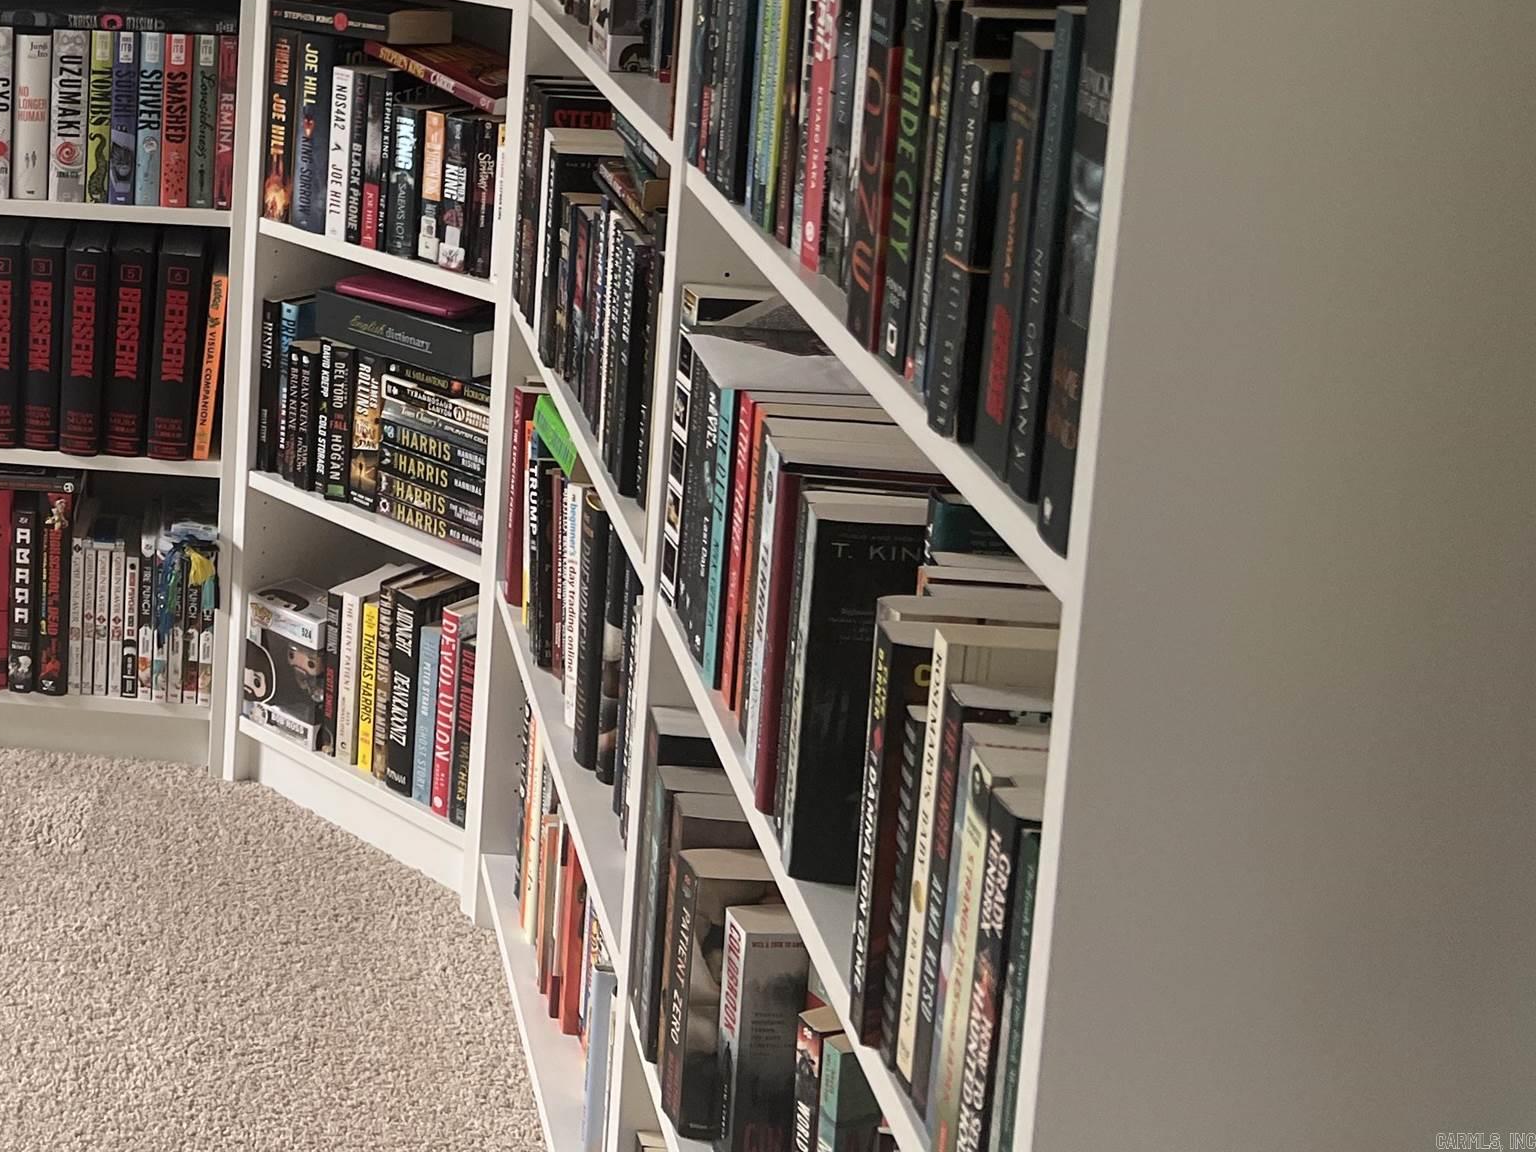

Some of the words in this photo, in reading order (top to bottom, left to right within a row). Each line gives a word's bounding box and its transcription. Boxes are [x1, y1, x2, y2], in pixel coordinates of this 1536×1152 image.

[283, 11, 315, 22] STEPHEN
[316, 15, 334, 25] KING
[304, 43, 319, 74] JOE
[378, 46, 410, 72] STEPHEN
[407, 62, 426, 79] KING
[18, 86, 30, 97] NO
[18, 98, 48, 109] LONGER
[57, 55, 83, 138] UZUMAKI
[90, 67, 113, 126] TOMBS
[138, 69, 163, 131] SHIVER
[165, 71, 188, 144] SMASHED
[272, 93, 287, 123] JOE
[303, 76, 318, 107] HILL
[333, 84, 348, 131] NOS4A2
[897, 48, 922, 162] JADE
[17, 110, 46, 122] HUMAN
[218, 93, 235, 153] REMINA
[383, 91, 393, 135] STEPHEN
[270, 124, 286, 156] HILL
[382, 136, 391, 160] KING
[331, 163, 344, 190] JOE
[351, 142, 363, 187] BLACK
[444, 163, 458, 201] KING
[298, 165, 313, 214] SORROW
[954, 118, 975, 251] NEVERWHERE
[328, 191, 342, 216] HILL
[347, 189, 362, 231] PHONE
[890, 170, 913, 264] CITY
[1031, 248, 1045, 303] NEIL
[28, 280, 53, 373] BERSERK
[70, 286, 96, 379] BERSERK
[115, 287, 141, 380] BERSERK
[161, 289, 189, 383] BERSERK
[386, 328, 432, 350] dictionary
[206, 331, 216, 365] VISUAL
[322, 344, 331, 369] DAVID
[290, 366, 299, 397] BRIAN
[301, 369, 311, 398] BRIAN
[320, 370, 330, 398] KOEPP
[334, 362, 345, 380] DEL
[200, 367, 213, 426] COMPANION
[332, 381, 344, 409] TORO
[357, 363, 372, 417] ROLLINS
[370, 377, 379, 409] JAMES
[406, 389, 453, 410] TYRANNOSAUR
[288, 398, 297, 432] KEENE
[298, 400, 309, 434] KEENE
[318, 415, 328, 435] COLD
[427, 402, 453, 418] CANYON
[316, 436, 326, 475] STORAGE
[330, 434, 342, 480] HOGAN
[401, 427, 451, 462] HARRIS
[457, 449, 485, 466] HANNIBAL
[399, 453, 449, 489] HARRIS
[461, 457, 481, 472] RISING
[396, 479, 446, 515] HARRIS
[453, 478, 483, 496] HANNIBAL
[529, 465, 540, 530] TRUMP
[396, 504, 447, 540] HARRIS
[702, 516, 710, 546] Last
[143, 566, 151, 584] FIRE
[568, 566, 578, 586] day
[699, 547, 707, 579] Days
[141, 585, 151, 616] PUNCH
[328, 608, 339, 623] THE
[567, 587, 577, 633] trading
[301, 627, 312, 640] 524
[326, 623, 338, 655] RUINS
[395, 603, 414, 658] MIDNIGHT
[363, 632, 376, 677] THOMAS
[566, 635, 576, 673] online
[360, 677, 374, 725] HARRIS
[433, 611, 459, 763] DEVOLUTION
[920, 651, 944, 799] ROSEMARY'S
[859, 767, 879, 909] DAMNATION
[980, 829, 1001, 938] HENDRIX
[991, 852, 1011, 938] GRADY
[928, 872, 943, 940] ALMA
[677, 906, 691, 989] PATIENT
[724, 923, 742, 1038] COLDBROOK
[670, 989, 684, 1045] ZERO
